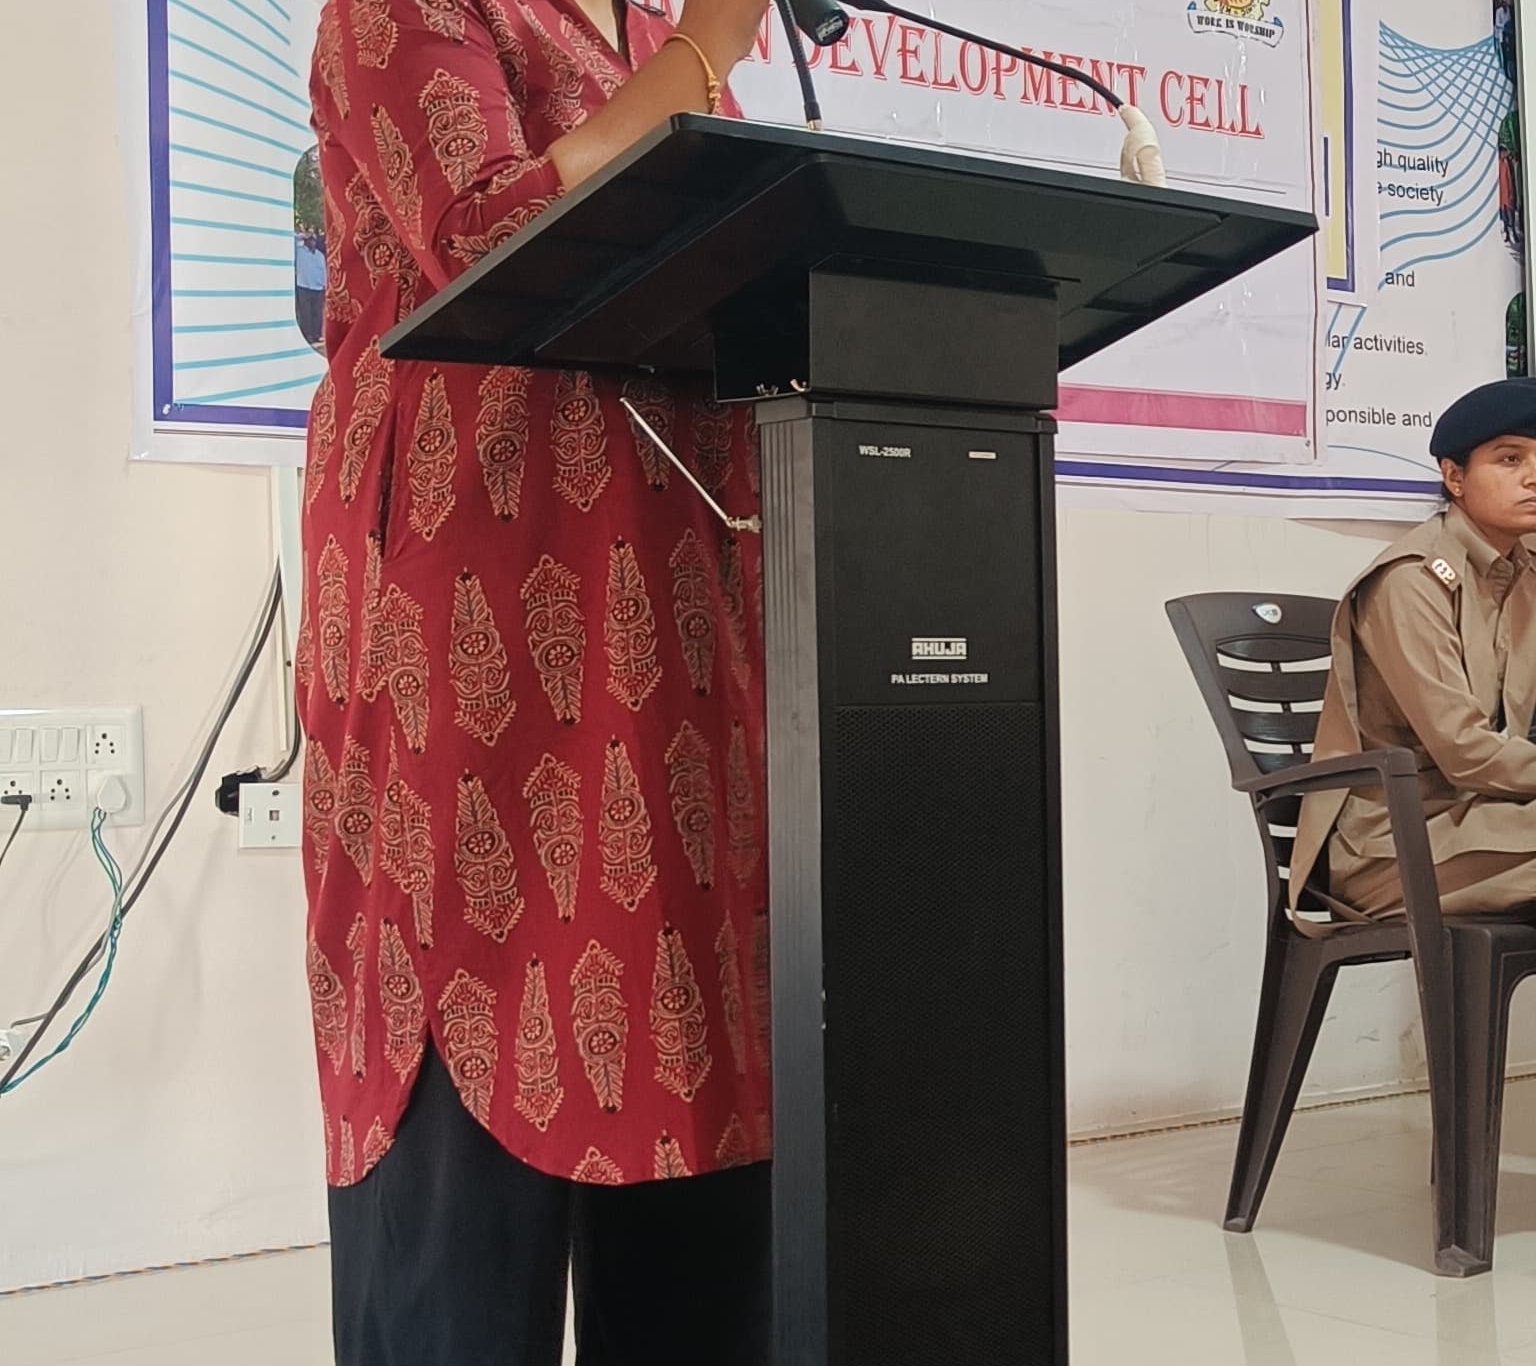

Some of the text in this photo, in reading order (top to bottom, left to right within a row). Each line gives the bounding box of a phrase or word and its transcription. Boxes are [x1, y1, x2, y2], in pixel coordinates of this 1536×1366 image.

[1197, 15, 1275, 39] WORK IS WORSHIP
[1158, 69, 1264, 139] CELL
[1398, 153, 1448, 177] quality
[1385, 271, 1415, 287] and
[1325, 407, 1432, 428] ponsible and
[912, 641, 967, 656] AHUJA
[891, 673, 988, 684] PA LECTERN SYSTEM
